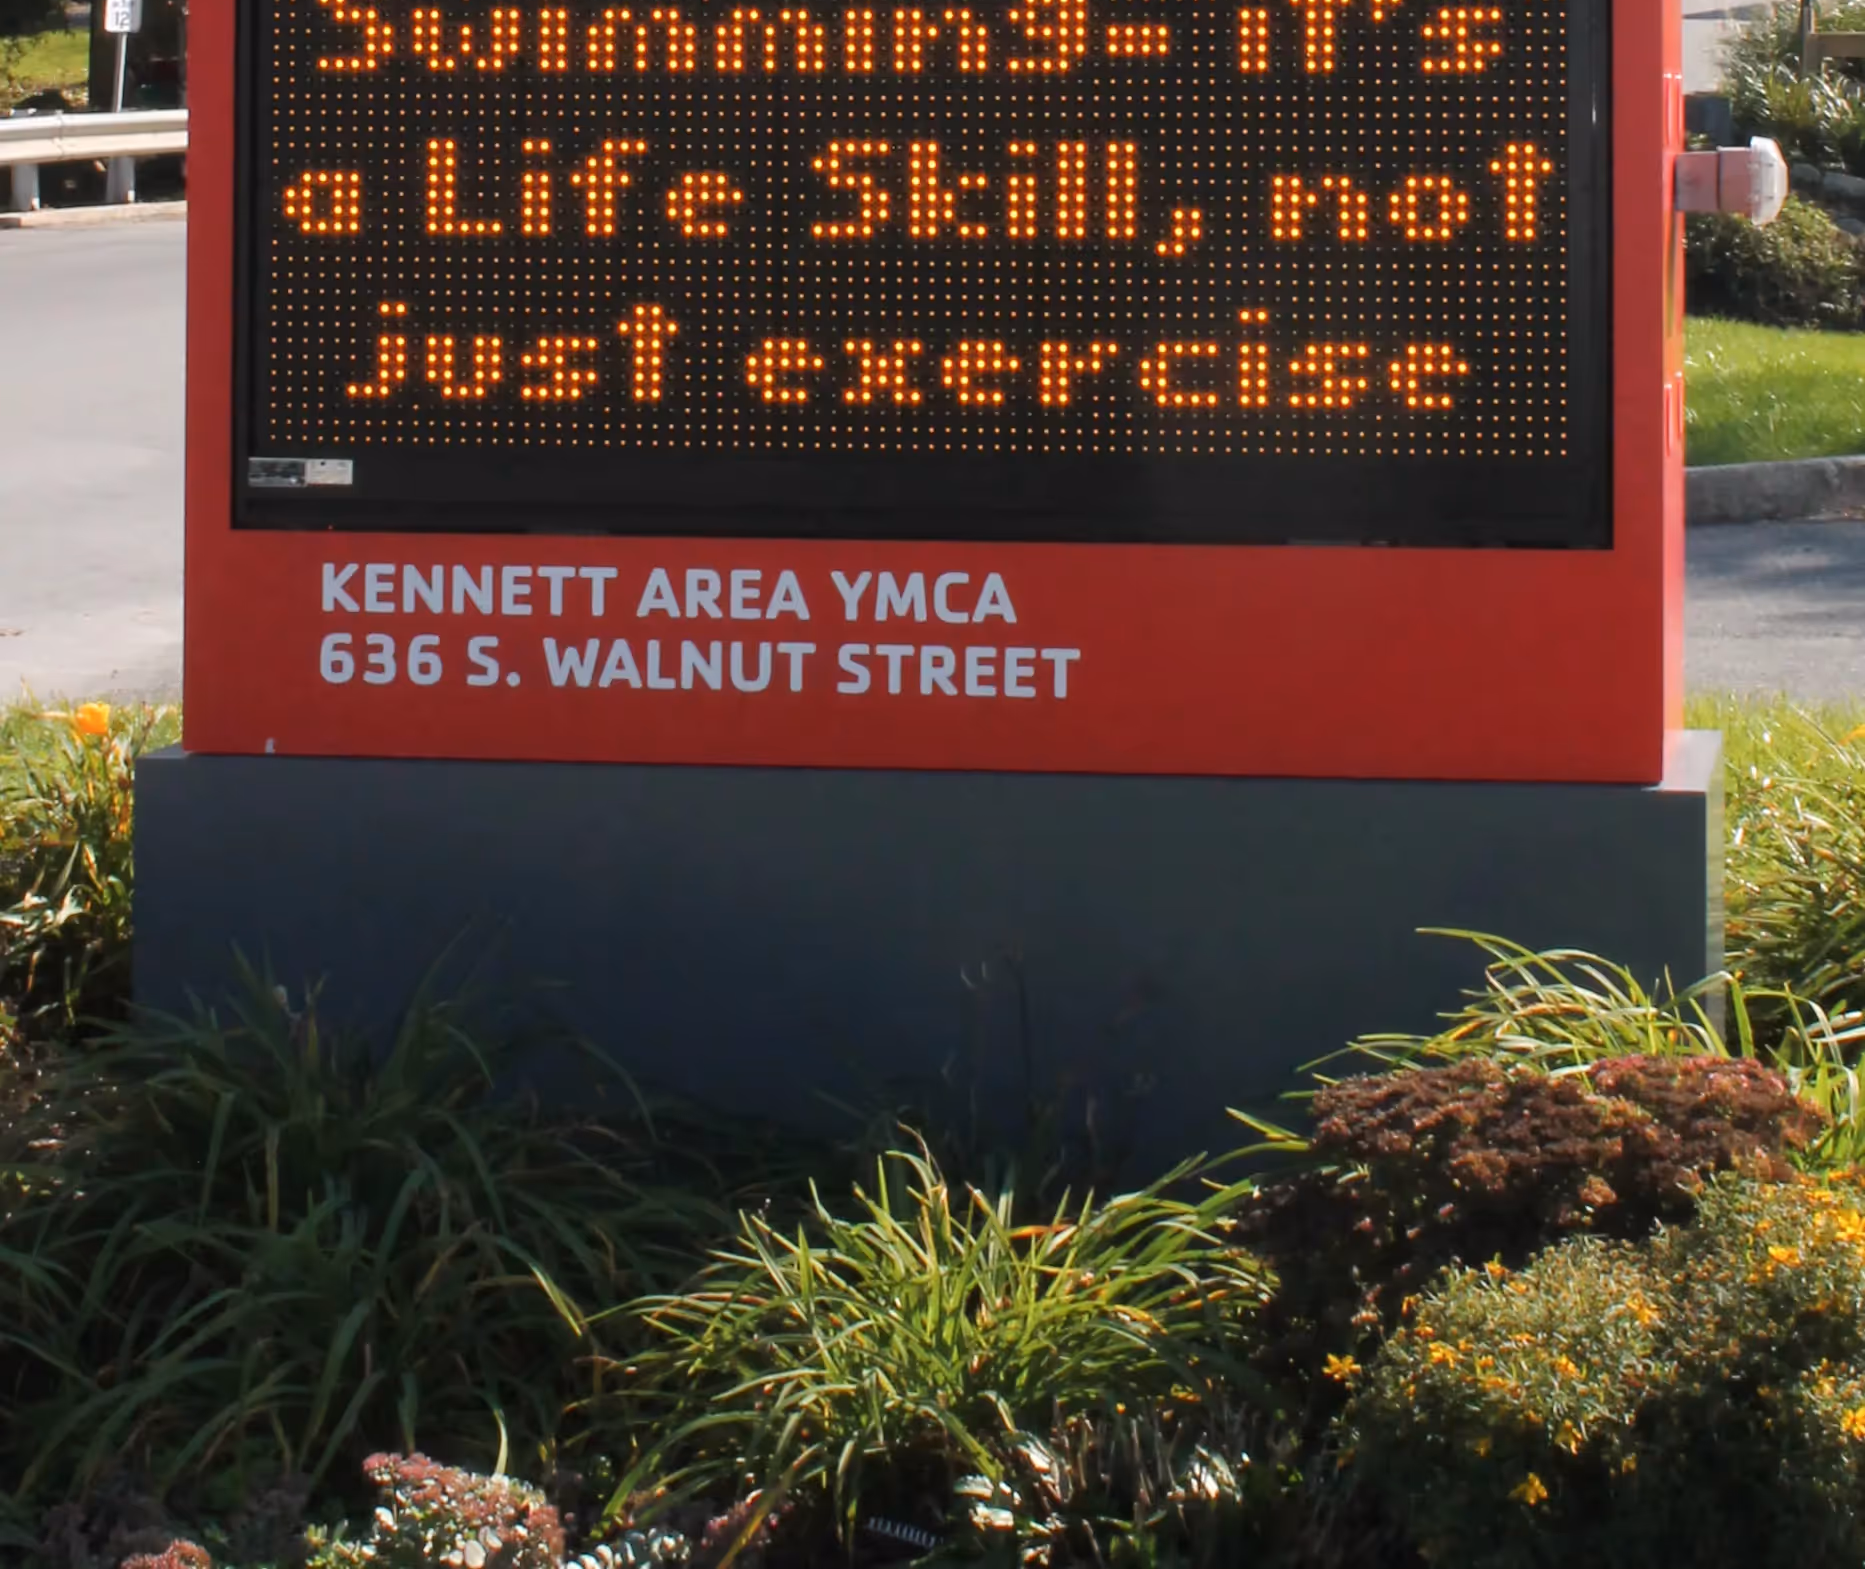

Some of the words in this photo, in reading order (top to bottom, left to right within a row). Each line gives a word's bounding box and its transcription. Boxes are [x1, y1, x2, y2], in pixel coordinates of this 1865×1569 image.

[283, 170, 361, 235] a
[425, 138, 745, 237] Life
[811, 139, 1204, 257] Skill,
[1271, 142, 1554, 241] not
[346, 301, 680, 402] just
[745, 309, 1471, 410] exercise
[321, 562, 619, 618] KENNETT
[636, 567, 811, 621] AREA
[829, 570, 1018, 625] YMCA
[319, 632, 444, 686] 636
[465, 635, 522, 688] S.
[543, 637, 817, 693] WALNUT
[836, 643, 1082, 699] STREET
